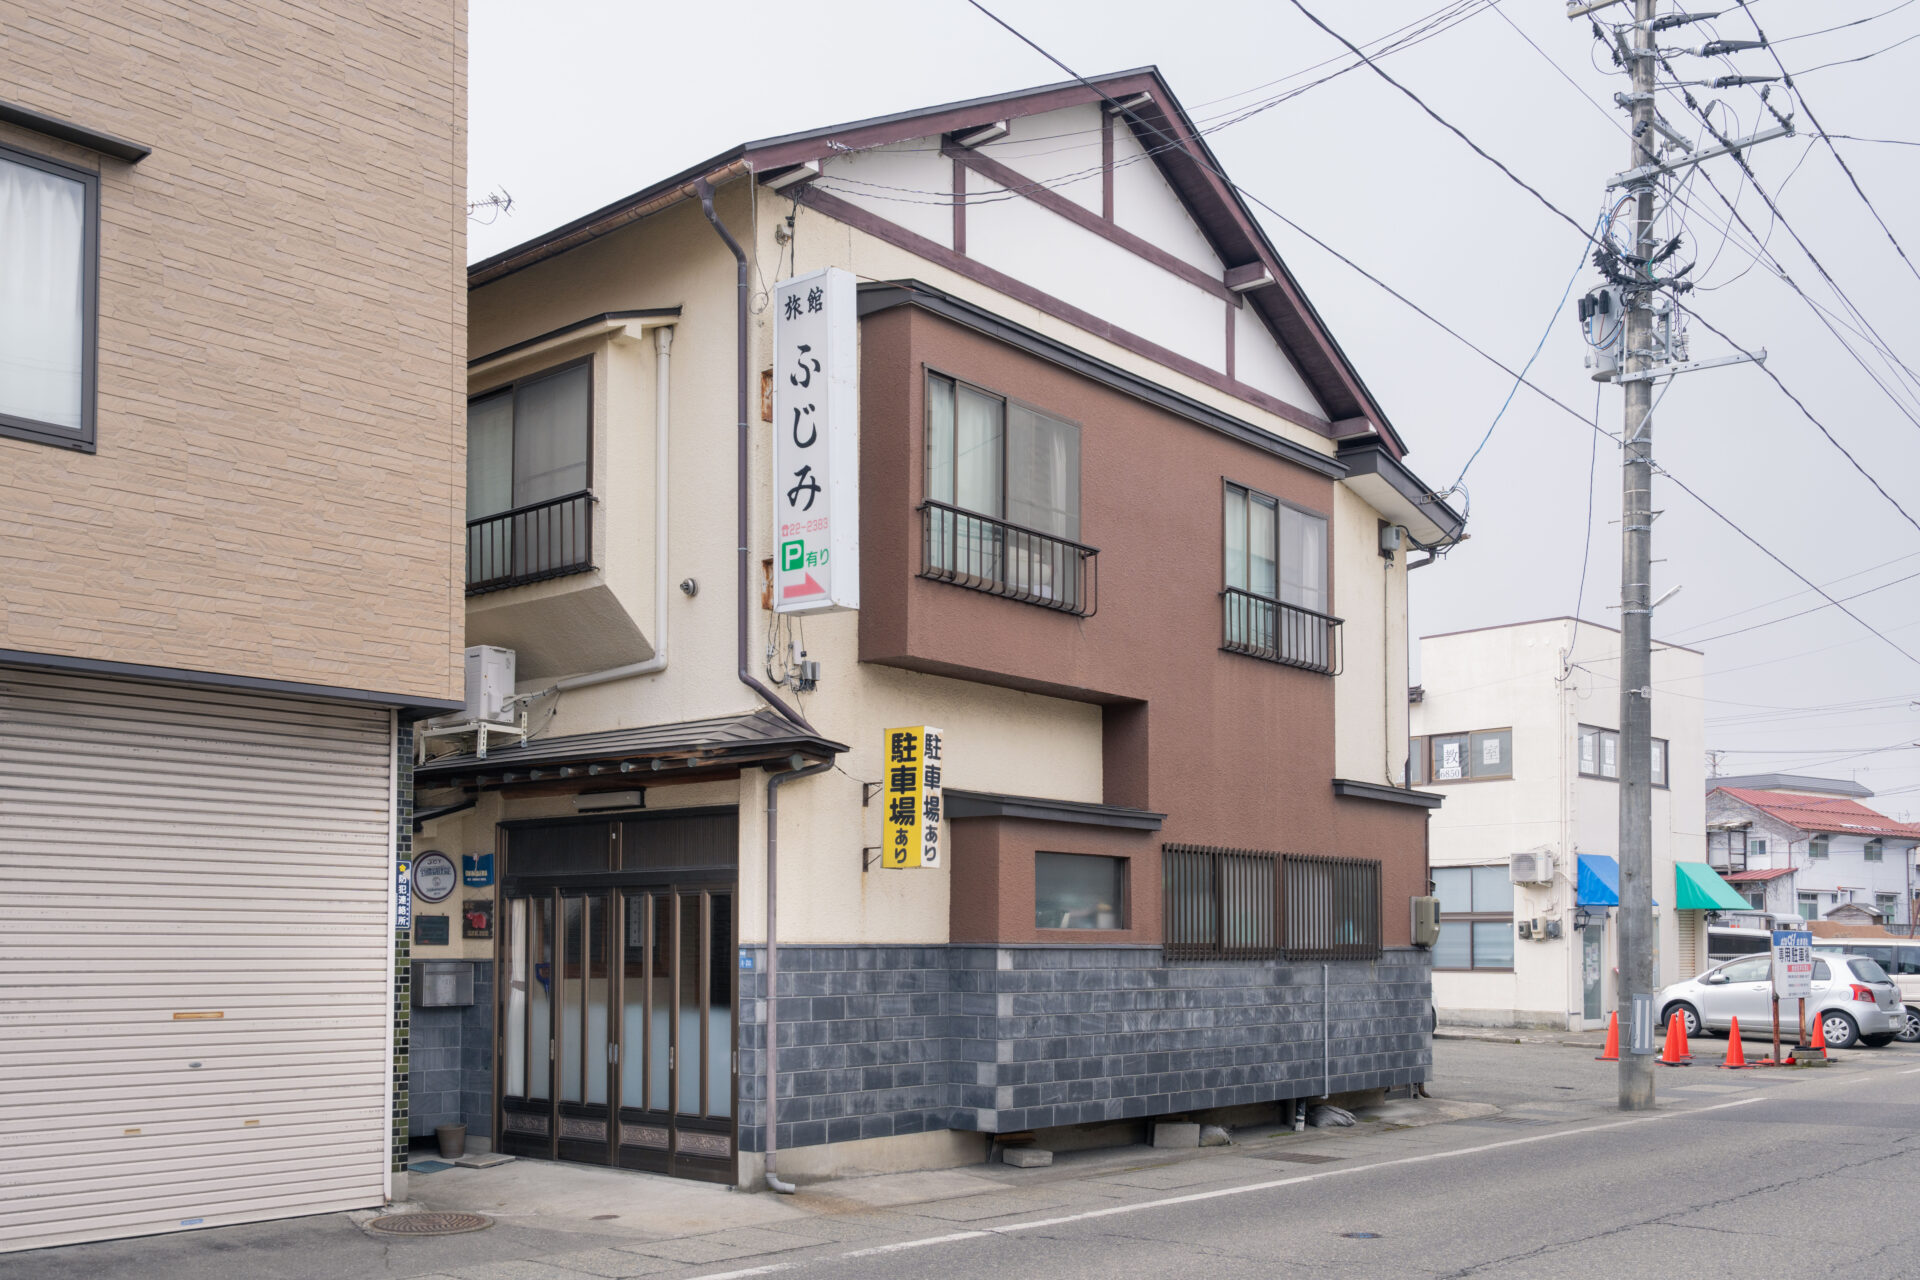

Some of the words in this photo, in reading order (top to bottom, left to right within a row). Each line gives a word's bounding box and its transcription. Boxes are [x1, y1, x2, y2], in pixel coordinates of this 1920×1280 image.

[784, 286, 824, 321] 旅館
[786, 344, 821, 512] ふじみ
[789, 517, 829, 535] 22-2383
[889, 732, 917, 864] 駐車場あり
[923, 733, 942, 861] 駐車場あり
[1441, 768, 1460, 778] 6850
